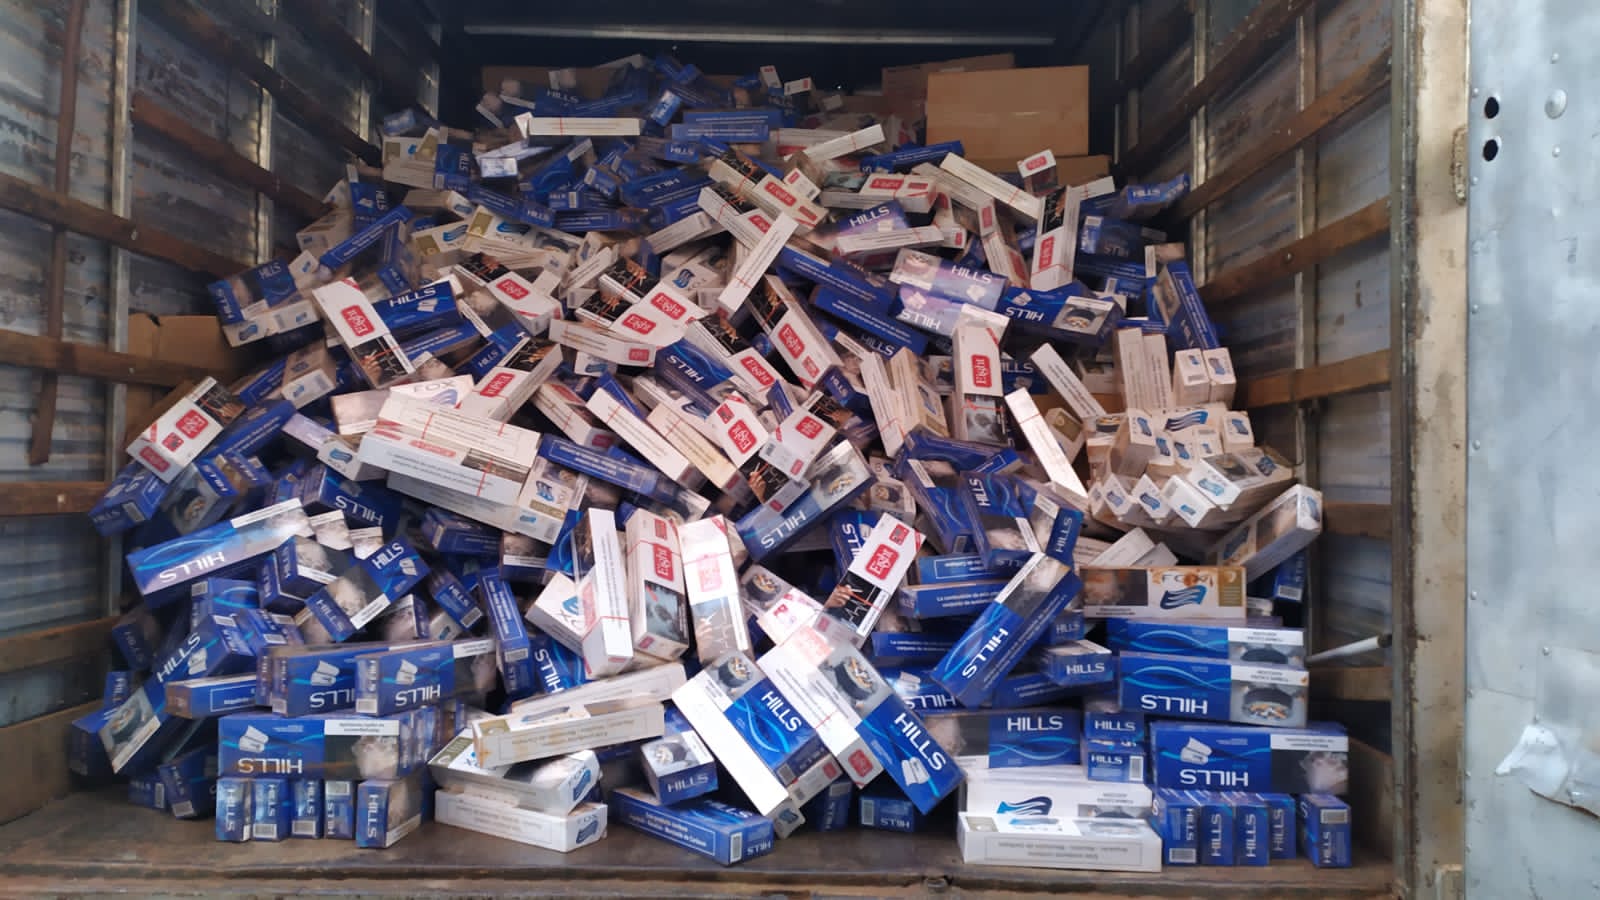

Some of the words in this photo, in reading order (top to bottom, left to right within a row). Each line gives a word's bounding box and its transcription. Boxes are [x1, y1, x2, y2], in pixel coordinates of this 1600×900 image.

[641, 177, 680, 192] HILLS
[849, 207, 890, 227] HILLS
[951, 265, 992, 283] HILLS
[389, 288, 437, 308] HILLS
[500, 280, 528, 299] Eight
[656, 294, 682, 318] Eight
[1005, 306, 1045, 322] HILLS
[347, 310, 367, 335] Eight
[629, 316, 652, 332] Eight
[898, 310, 940, 330] HILLS
[783, 326, 802, 355] Eight
[860, 334, 895, 355] HILLS
[478, 350, 499, 368] HILLS
[667, 355, 704, 383] HILLS
[745, 359, 772, 384] Eight
[975, 358, 986, 385] Eight
[486, 374, 513, 395] Eight
[830, 375, 848, 395] HILLS
[733, 425, 753, 450] Eight
[969, 479, 991, 507] HILLS
[335, 495, 384, 526] HILLS
[761, 511, 807, 549] HILLS
[841, 523, 864, 559] ILLS
[1056, 517, 1072, 553] HILLS
[160, 551, 225, 583] HILLS
[372, 542, 404, 570] HILLS
[656, 546, 670, 576] Eight
[870, 547, 894, 575] Eight
[448, 584, 470, 605] HILLS
[316, 599, 344, 632] HILLS
[1056, 623, 1080, 633] HILLS
[157, 632, 200, 683] HILLS
[962, 628, 1008, 678] HILLS
[535, 649, 564, 693] HILLS
[1066, 663, 1105, 675] HILLS
[311, 687, 355, 708] ILLS
[396, 685, 440, 706] HILLS
[905, 695, 957, 709] HILLS
[1140, 695, 1208, 714] HILLS
[762, 691, 802, 732] HILLS
[1007, 716, 1062, 731] HILLS
[1095, 720, 1135, 731] HILLS
[894, 713, 946, 771] HILLS
[238, 757, 302, 774] HILLS
[1091, 755, 1122, 765] HILLS
[667, 774, 709, 793] HILLS
[1180, 769, 1249, 786] HILLS
[226, 788, 236, 832] HILLS
[368, 794, 378, 838] HILLS
[880, 818, 910, 828] HILLS
[1273, 808, 1283, 851] HILLS
[1211, 813, 1221, 857] HILLS
[1246, 814, 1256, 858] HILLS
[747, 842, 771, 855] HILLS
